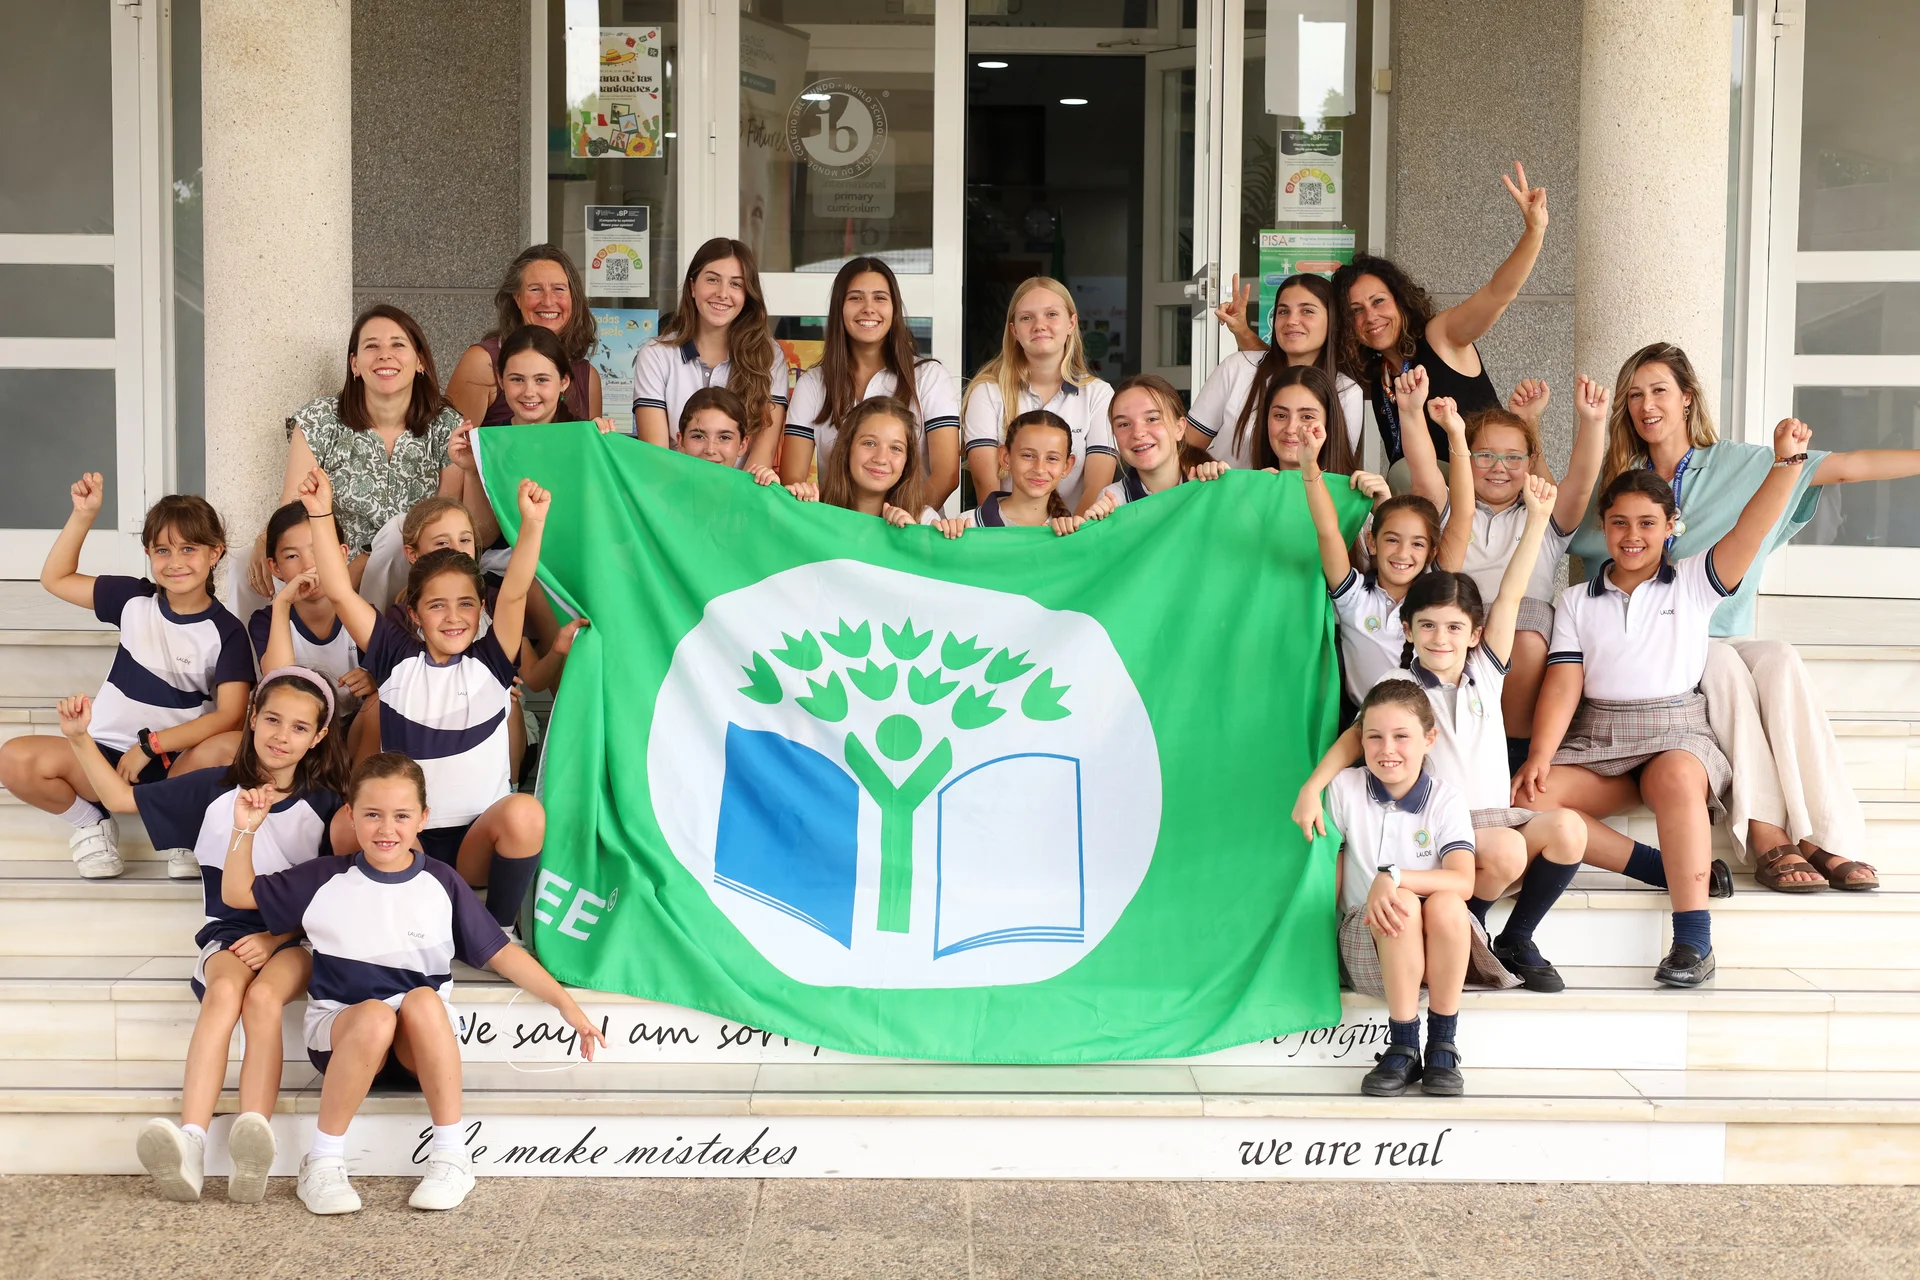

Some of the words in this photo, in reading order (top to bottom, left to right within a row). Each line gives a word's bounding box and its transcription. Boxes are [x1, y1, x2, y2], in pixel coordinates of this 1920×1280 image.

[622, 75, 635, 83] de
[637, 75, 653, 83] las
[599, 84, 651, 93] anidades
[807, 82, 835, 95] UNDO
[793, 101, 806, 117] DEL
[844, 83, 872, 103] WORLD
[870, 104, 884, 138] SCHOOL
[815, 100, 859, 154] ib
[790, 118, 804, 156] COLEGIO
[807, 160, 838, 177] MONDE
[841, 167, 854, 176] DU
[834, 191, 874, 203] primary
[826, 203, 881, 213] curriculum
[1261, 234, 1288, 247] PISA
[600, 326, 624, 337] uelo
[1660, 608, 1675, 616] LAUDE
[1416, 849, 1433, 858] LAUDE
[408, 930, 425, 939] LAUDE
[512, 1023, 578, 1056] say
[629, 1023, 699, 1045] am
[717, 1024, 820, 1057] sor
[493, 1126, 608, 1165] make
[614, 1126, 798, 1165] mistakes
[1238, 1138, 1293, 1166] we
[1305, 1141, 1361, 1166] are
[1374, 1128, 1452, 1167] real
